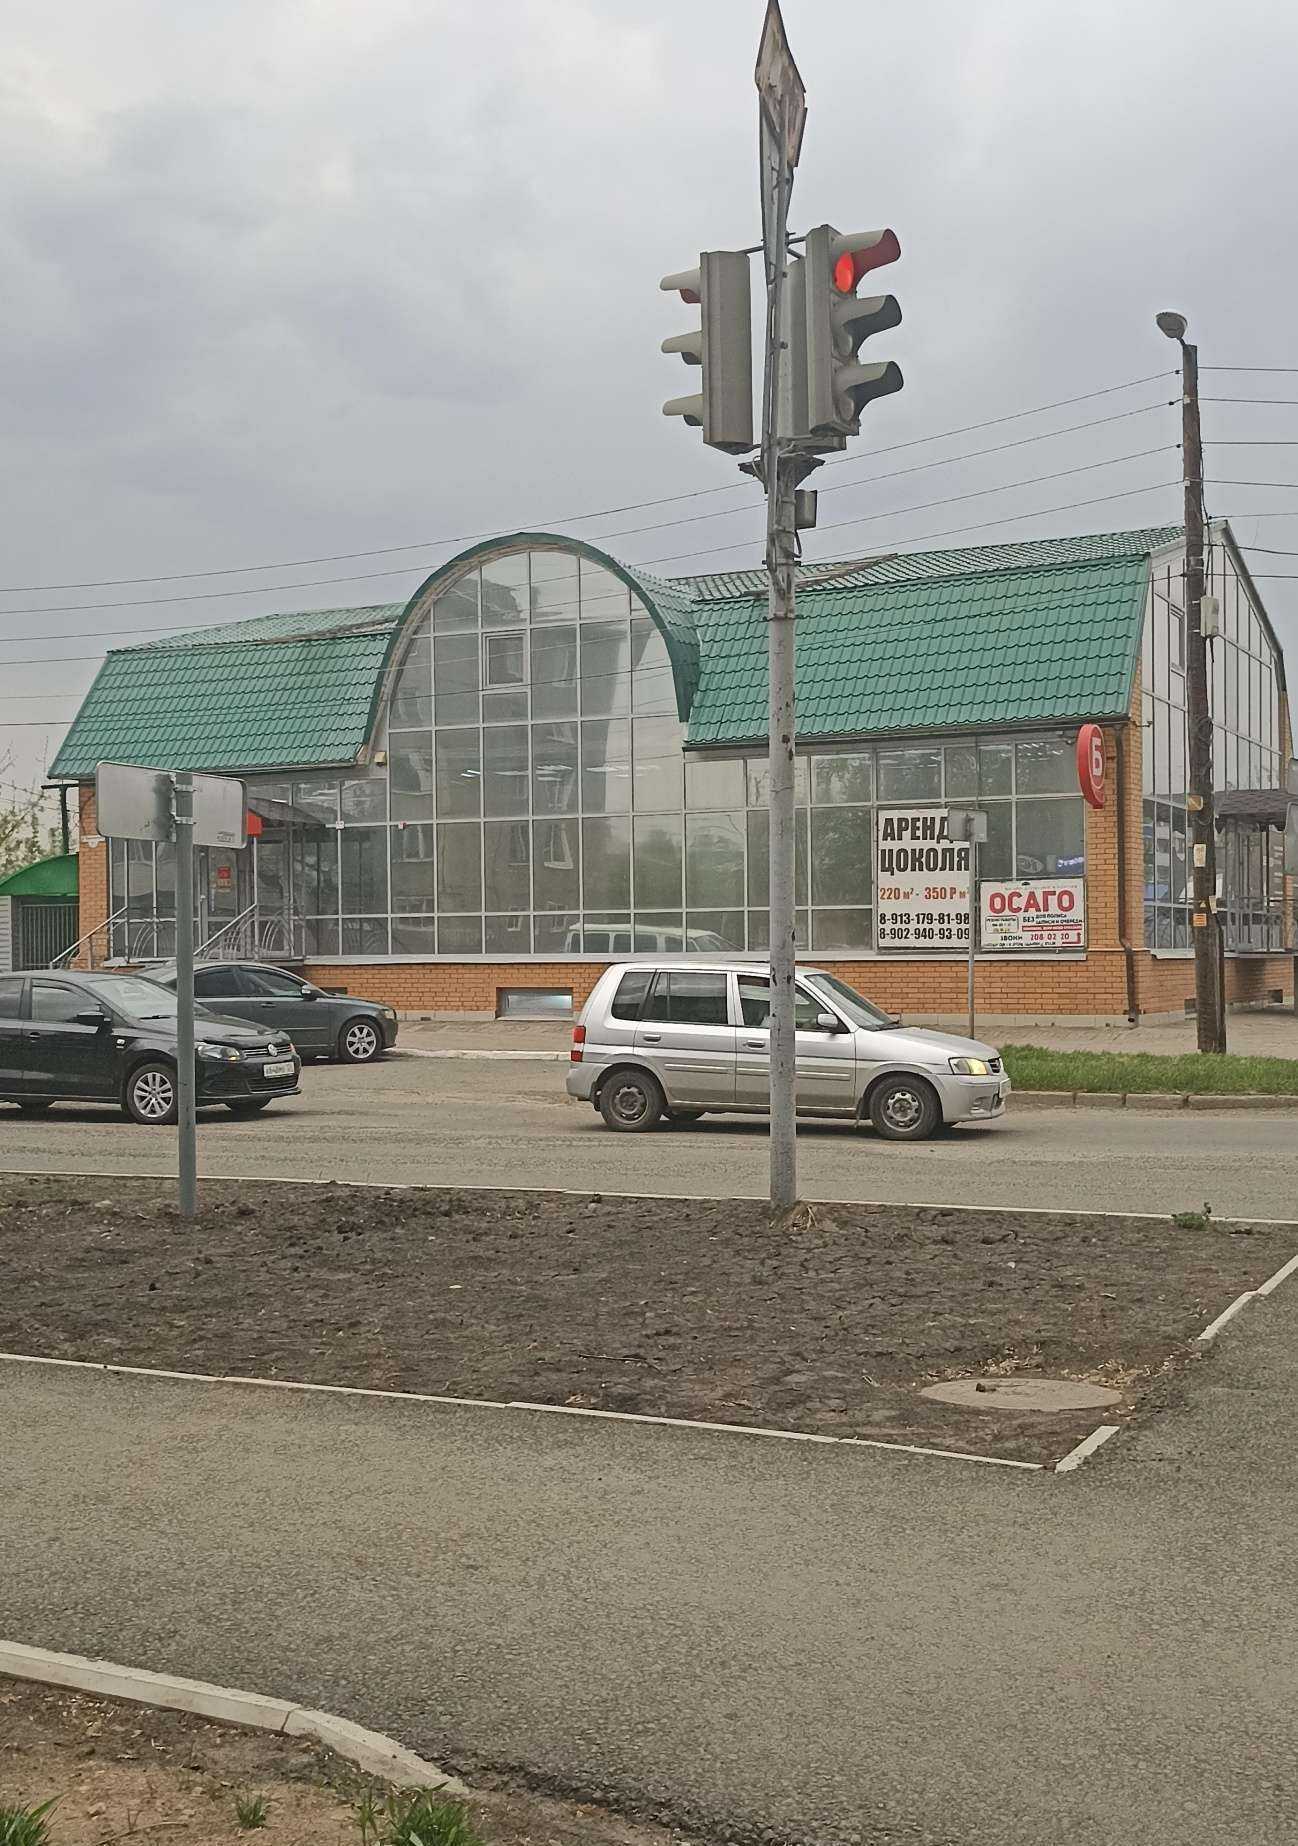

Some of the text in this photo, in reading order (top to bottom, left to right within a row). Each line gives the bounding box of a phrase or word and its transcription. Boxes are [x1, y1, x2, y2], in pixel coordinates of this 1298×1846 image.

[1091, 737, 1103, 776] Б
[882, 817, 955, 844] АРЕНД
[880, 848, 969, 876] ЦОКОЛЯ
[880, 887, 901, 900] 220
[924, 886, 947, 900] 350
[989, 890, 1075, 914] ОСАГО
[879, 912, 970, 925] 8-913-179-81-98
[879, 927, 970, 940] 8-902-940-93-09
